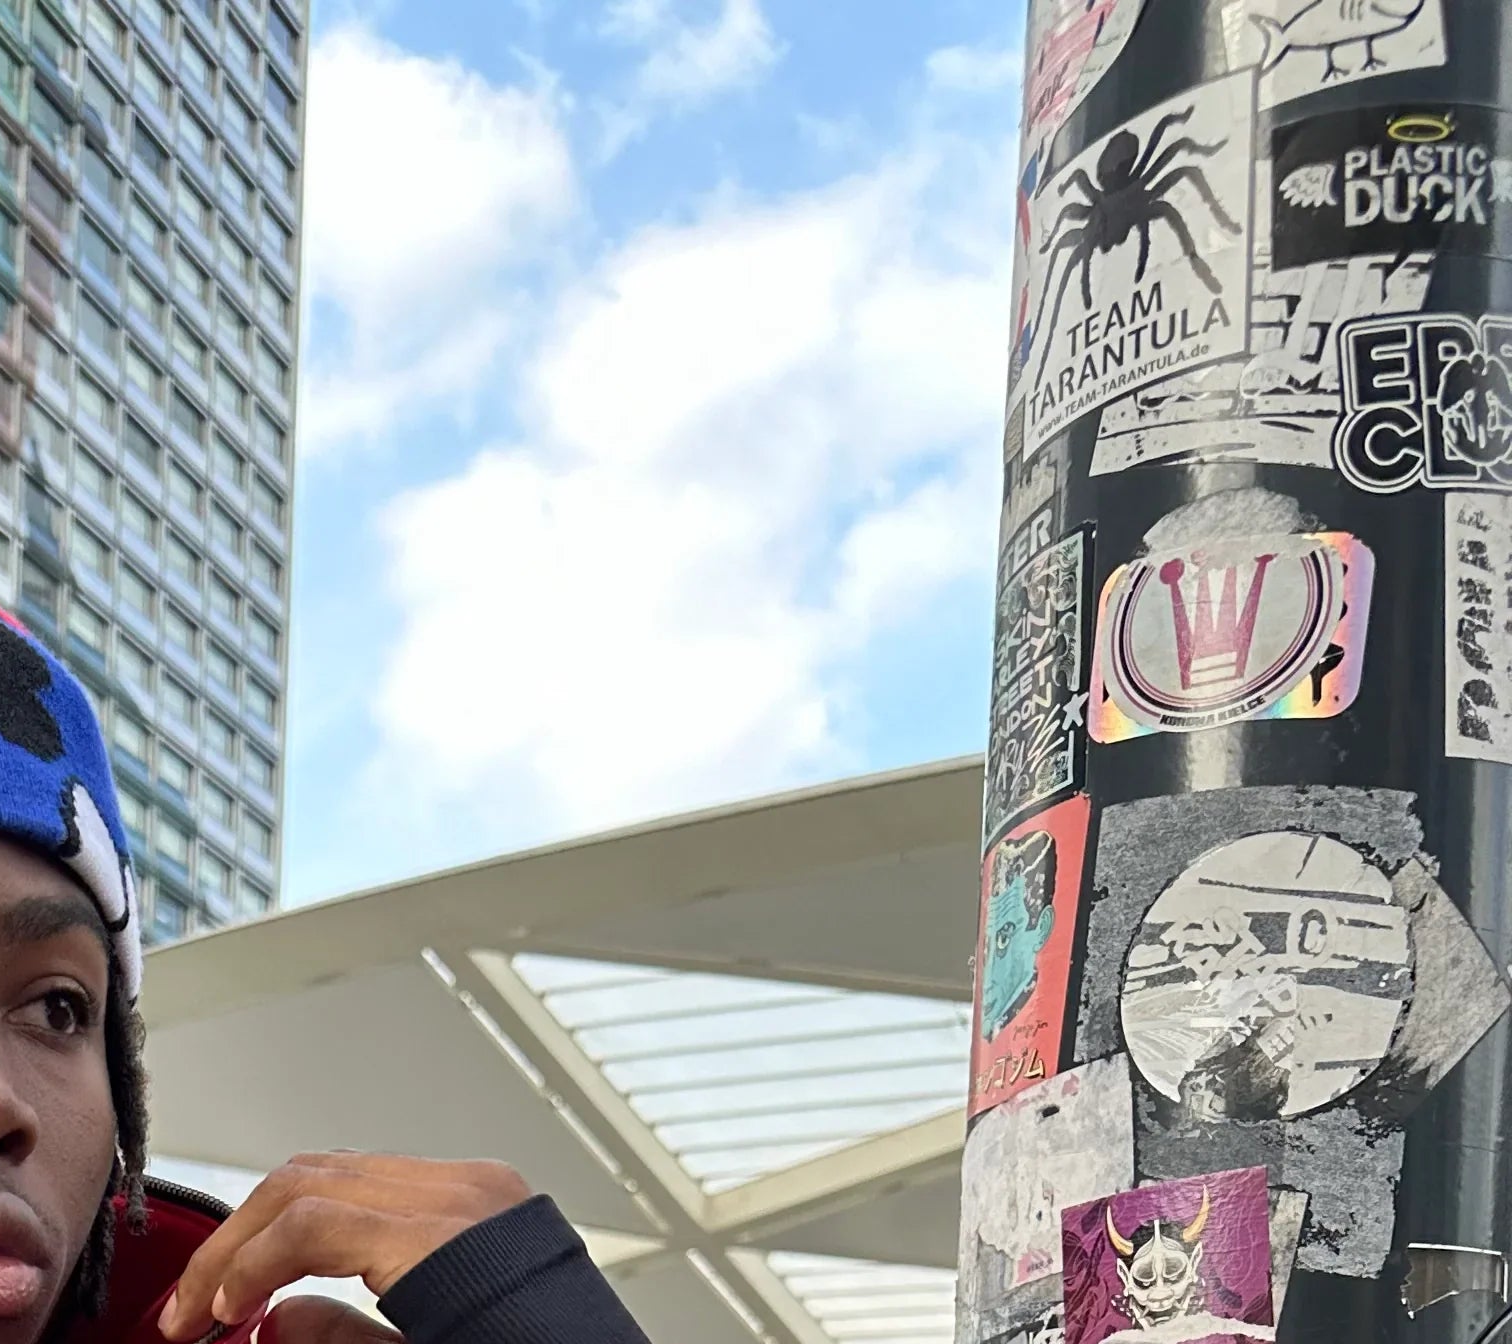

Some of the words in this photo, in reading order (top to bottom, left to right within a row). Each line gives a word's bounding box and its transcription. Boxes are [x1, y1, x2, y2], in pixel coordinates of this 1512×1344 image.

[1344, 144, 1487, 179] PLASTIC
[1344, 174, 1486, 227] DUCK
[1066, 280, 1163, 358] TEAM
[1028, 297, 1231, 426] TARANTULA
[1037, 342, 1210, 440] www.TEAM-TARANTULA.de
